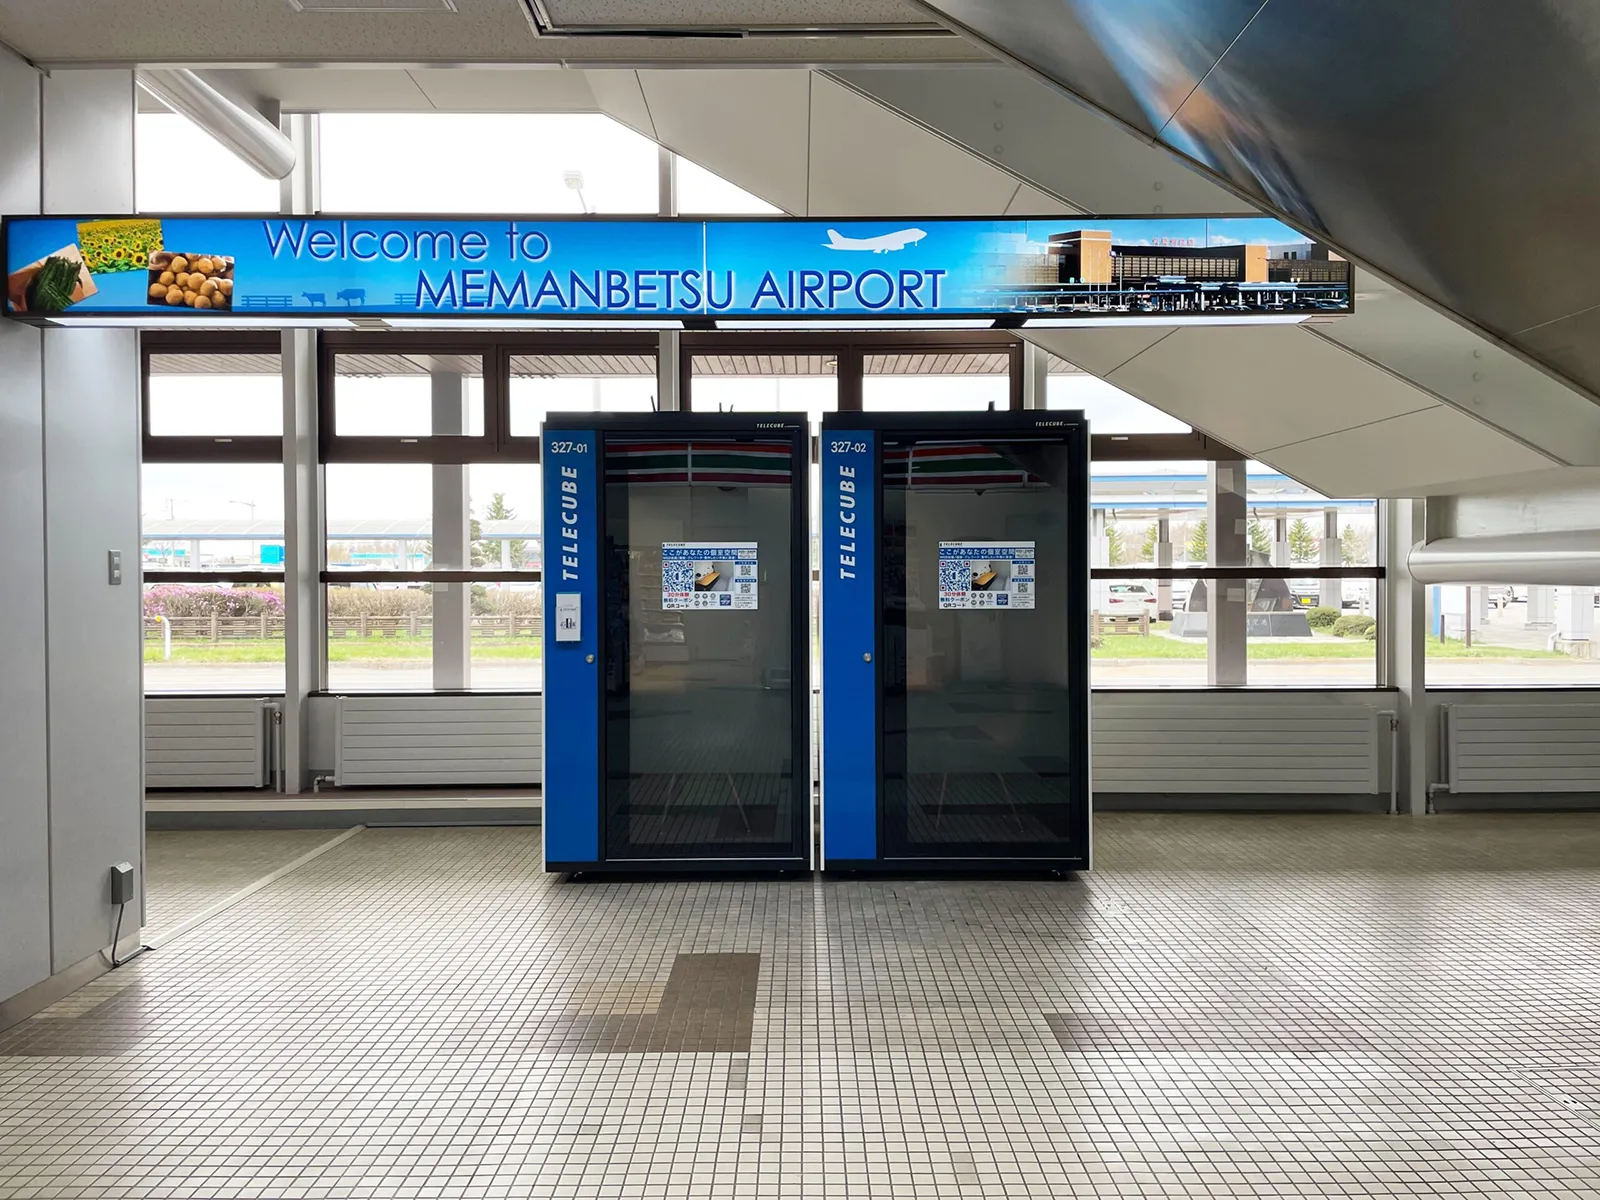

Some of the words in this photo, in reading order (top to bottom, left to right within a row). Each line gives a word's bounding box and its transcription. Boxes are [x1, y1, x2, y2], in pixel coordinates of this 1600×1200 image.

[263, 220, 488, 261] Welcome
[505, 221, 549, 260] to
[416, 269, 733, 312] MEMANBETSU
[751, 269, 946, 311] AIRPORT
[551, 441, 588, 454] 327-01
[830, 441, 867, 453] 327-02
[561, 466, 578, 581] TELECUBE
[839, 465, 856, 580] TELECUBE
